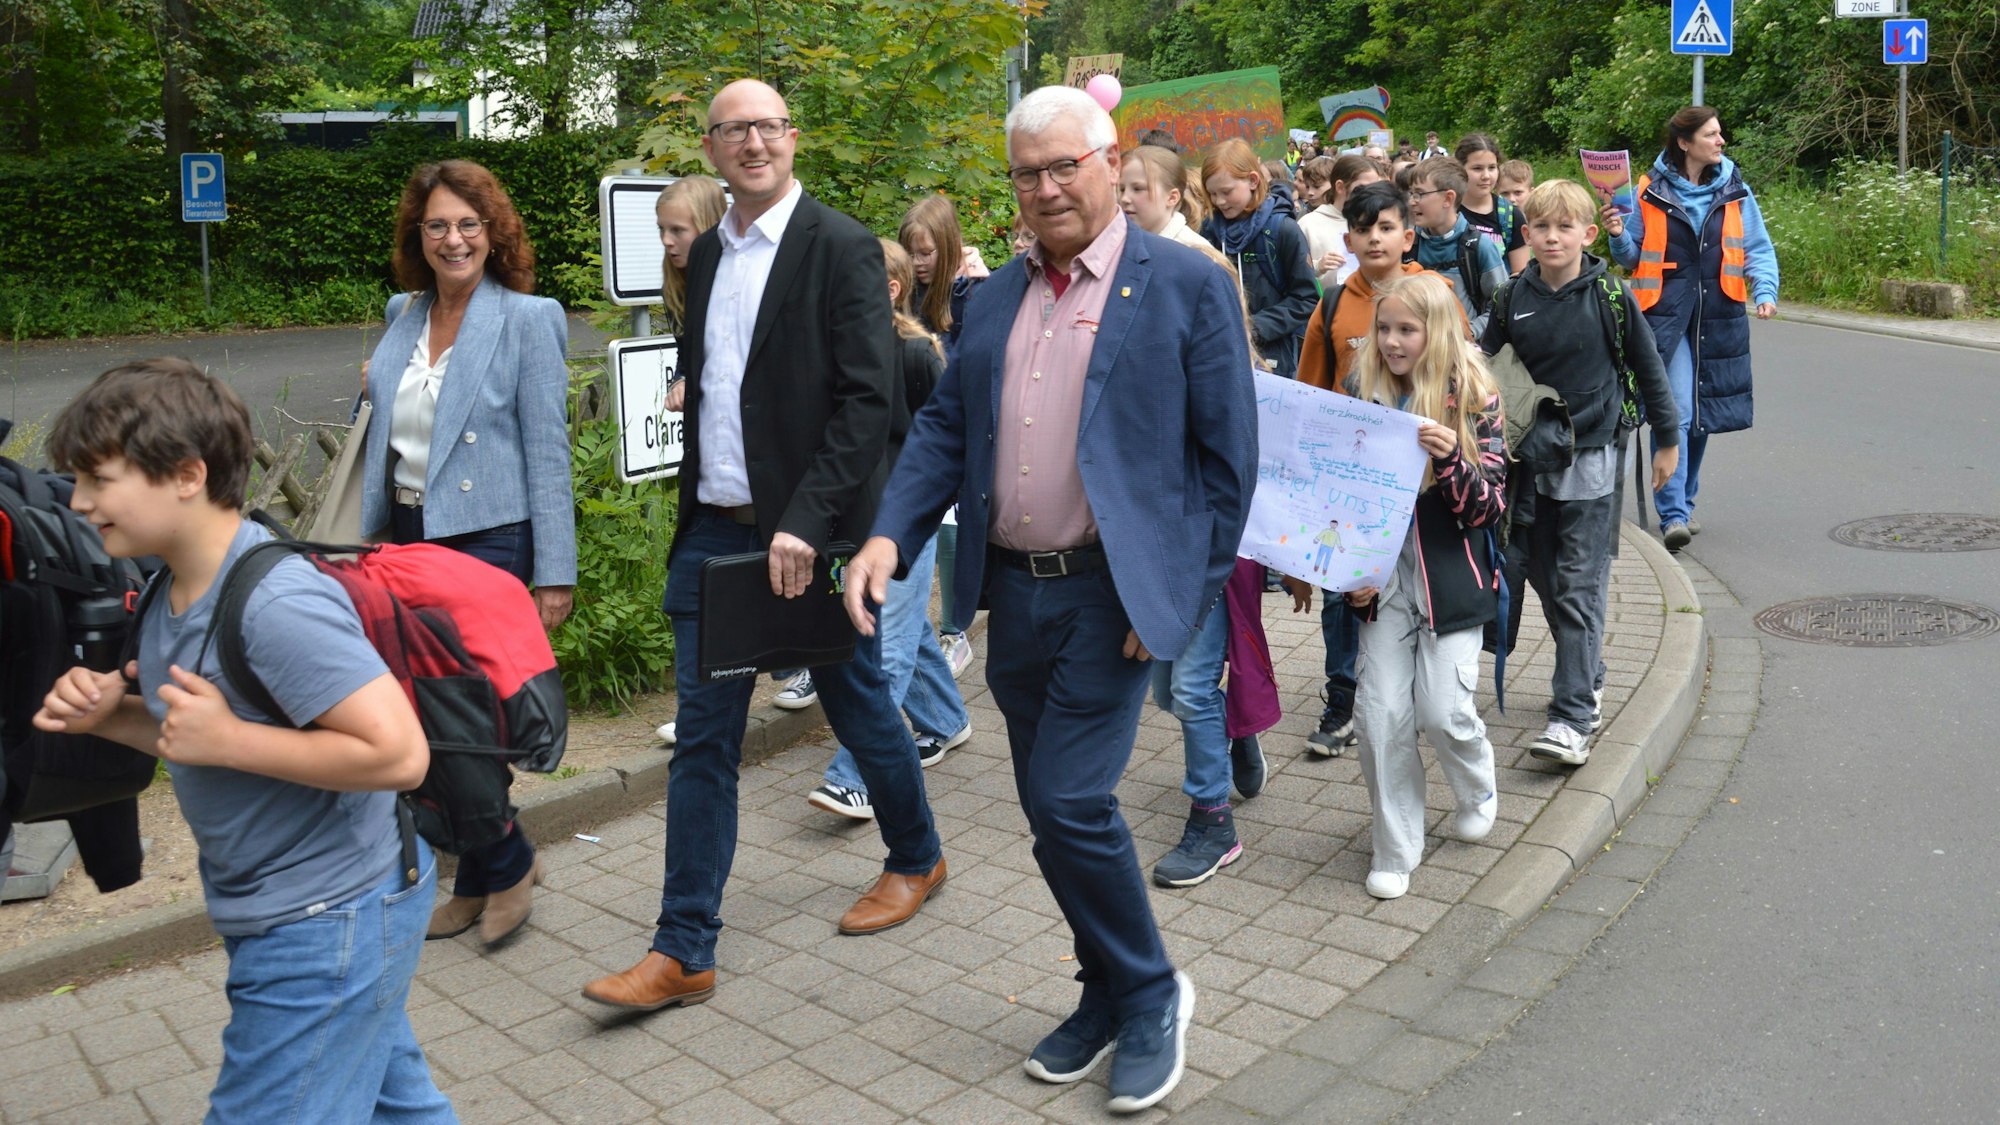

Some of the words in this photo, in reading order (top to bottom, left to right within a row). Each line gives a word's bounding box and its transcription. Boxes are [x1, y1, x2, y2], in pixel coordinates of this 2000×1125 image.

[1851, 2, 1880, 12] ZONE
[1582, 153, 1626, 161] Nationalität
[1588, 163, 1621, 171] MENSCH
[190, 161, 216, 198] P
[185, 200, 222, 208] Besucher
